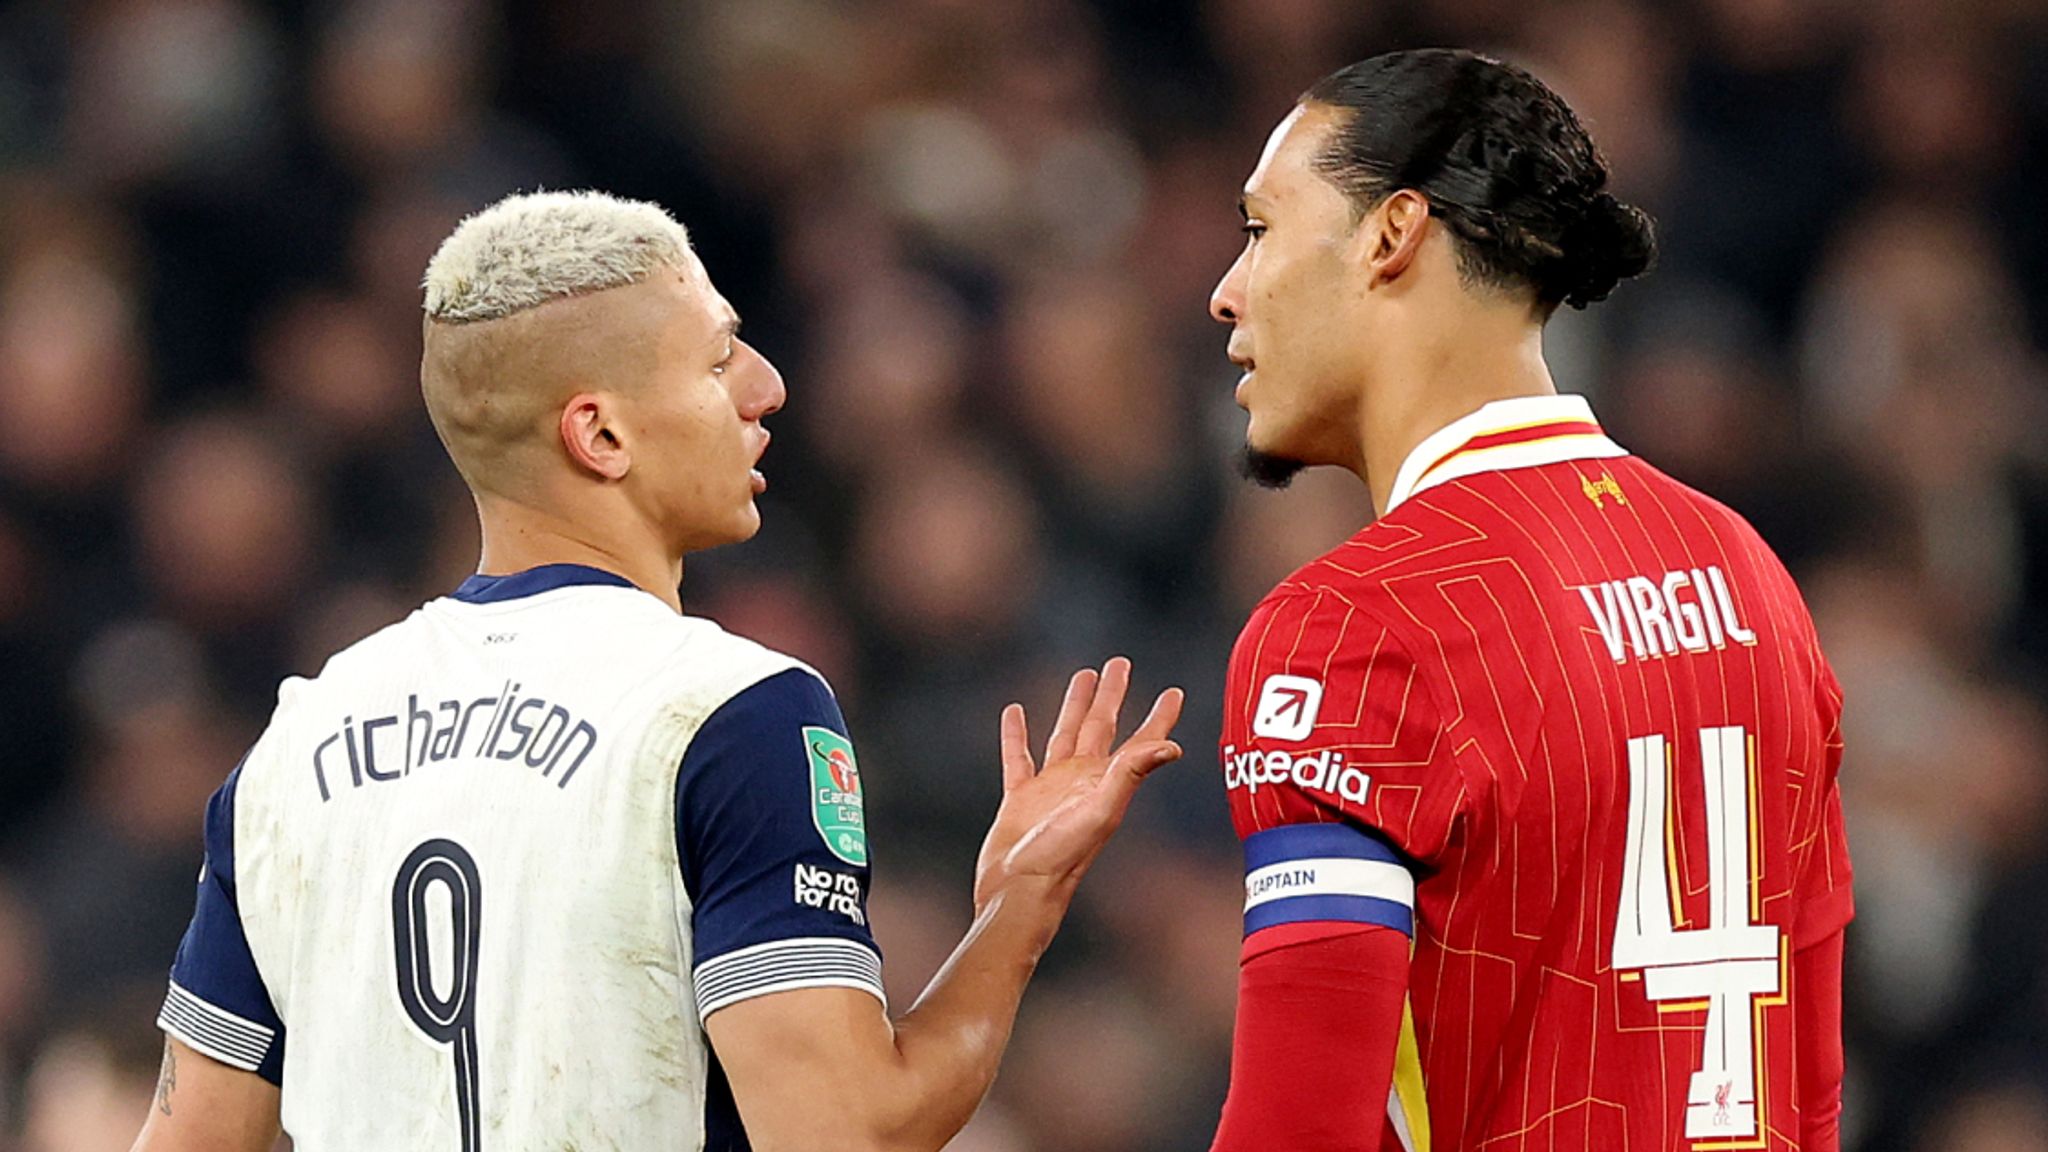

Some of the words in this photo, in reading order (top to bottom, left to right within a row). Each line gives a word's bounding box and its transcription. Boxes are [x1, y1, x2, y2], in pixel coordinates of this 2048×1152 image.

[1578, 566, 1757, 664] VIRGIL
[313, 679, 597, 802] richarlison
[1224, 744, 1370, 805] Expedia
[795, 863, 832, 888] No
[795, 884, 829, 907] For
[1253, 869, 1315, 896] CAPTAIN
[1612, 726, 1787, 1150] 4
[392, 838, 481, 1152] 9
